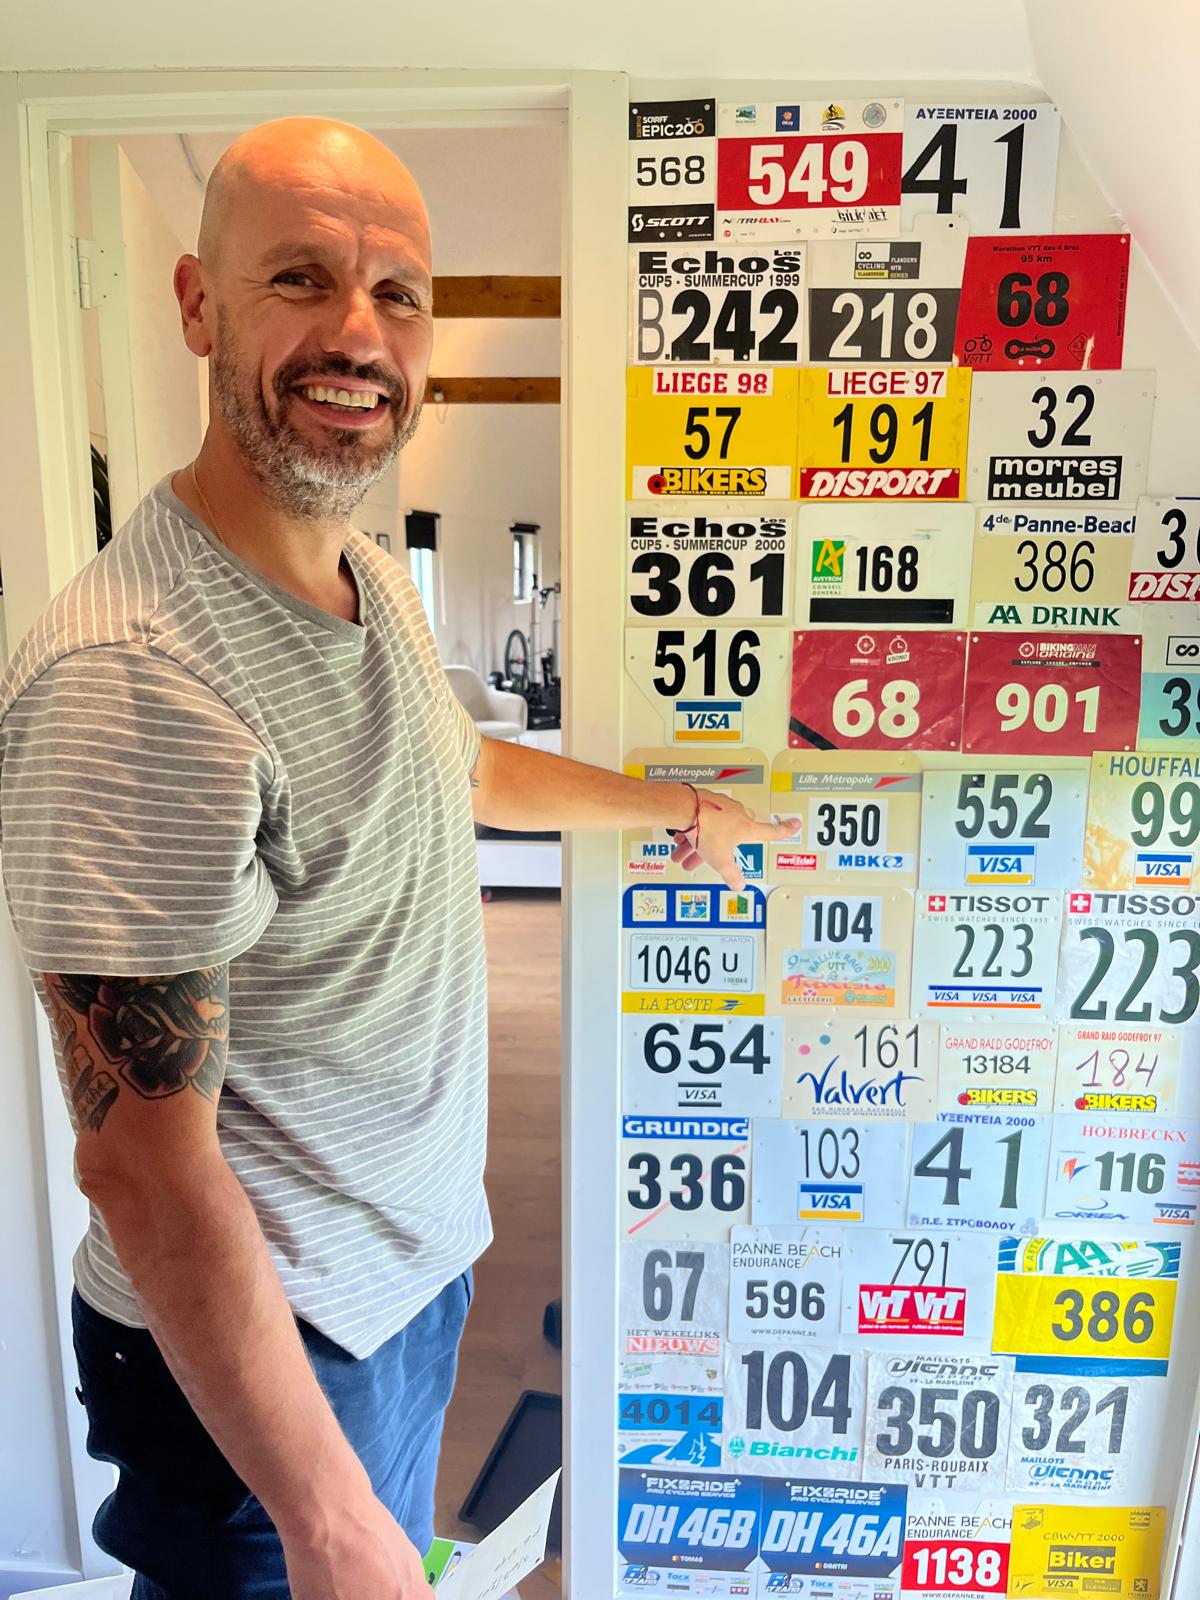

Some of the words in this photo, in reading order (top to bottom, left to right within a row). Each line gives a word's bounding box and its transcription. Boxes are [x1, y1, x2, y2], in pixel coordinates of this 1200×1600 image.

[1002, 109, 1037, 120] 2000
[636, 155, 705, 187] 568
[747, 140, 869, 206] 549
[901, 122, 1025, 229] 41
[645, 216, 710, 228] SCOTT
[638, 250, 801, 275] Echos
[773, 249, 802, 257] Les
[1021, 255, 1034, 264] 95
[1036, 254, 1053, 263] km
[639, 275, 672, 288] CUP5
[684, 274, 764, 288] SUMMERCUP
[769, 273, 800, 288] 1999
[997, 271, 1070, 328] 68
[828, 292, 938, 360] 218
[656, 372, 728, 394] LIEGE
[738, 373, 768, 395] 98
[827, 371, 906, 396] LIEGE
[914, 371, 945, 395] 97
[1027, 384, 1095, 449] 32
[684, 407, 741, 460] 57
[833, 401, 934, 464] 191
[994, 457, 1118, 476] morres
[662, 468, 767, 492] BIKERS
[808, 469, 953, 497] DISPORT
[992, 477, 1116, 498] meubel
[630, 517, 787, 538] Echos
[1156, 508, 1200, 569] 3
[631, 539, 662, 551] CUP5
[673, 539, 748, 551] SUMMERCUP
[755, 539, 786, 551] 2000
[856, 545, 919, 593] 168
[1014, 540, 1096, 593] 386
[630, 552, 785, 617] 361
[987, 605, 1023, 625] AA
[1032, 606, 1121, 627] DRINK
[653, 629, 760, 697] 516
[832, 679, 920, 739] 68
[995, 682, 1100, 734] 901
[1158, 677, 1200, 737] 3
[686, 713, 730, 729] VISA
[649, 767, 667, 777] Lille
[667, 767, 716, 781] Métropole
[799, 774, 818, 784] Lille
[821, 774, 873, 786] Métropole
[954, 773, 1053, 839] 552
[1130, 781, 1200, 848] 99
[817, 803, 881, 847] 350
[628, 862, 645, 870] Nord
[838, 854, 880, 868] MBK
[978, 857, 1022, 873] VISA
[1144, 863, 1182, 877] VISA
[949, 895, 1050, 913] TISSOT
[811, 901, 873, 943] 104
[1069, 918, 1099, 926] SWISS
[1105, 919, 1152, 927] WATCHES
[953, 923, 1034, 978] 223
[637, 944, 711, 984] 1046
[722, 953, 738, 973] U
[1069, 926, 1200, 1024] 223
[640, 998, 660, 1011] LA
[663, 998, 713, 1011] POSTE
[934, 991, 959, 1001] VISA
[971, 992, 997, 1002] VISA
[1010, 992, 1036, 1003] VISA
[854, 1023, 919, 1069] 161
[945, 1037, 978, 1050] GRAND
[980, 1037, 1002, 1050] RAID
[1004, 1037, 1054, 1051] GODEFROY
[1077, 1031, 1100, 1040] GRAND
[1101, 1032, 1117, 1041] RAID
[1118, 1032, 1153, 1042] GODEFROY
[1154, 1032, 1162, 1042] 97
[643, 1022, 771, 1075] 654
[962, 1054, 1031, 1075] 13184
[1076, 1048, 1159, 1088] 184
[796, 1055, 926, 1107] Valvert
[684, 1088, 718, 1101] VISA
[967, 1088, 1038, 1105] BIKERS
[1084, 1093, 1158, 1110] BIKERS
[1005, 1116, 1036, 1128] 2000
[1082, 1125, 1187, 1143] HOEBRECKX
[800, 1127, 860, 1179] 103
[914, 1126, 1023, 1209] 41
[1095, 1151, 1166, 1195] 116
[627, 1152, 746, 1212] 336
[811, 1194, 852, 1209] VISA
[1055, 1210, 1129, 1221] ORBEA
[1159, 1208, 1190, 1219] VISA
[733, 1243, 782, 1255] PANNE
[788, 1243, 841, 1258] BEACH
[1054, 1240, 1114, 1275] AA
[733, 1258, 800, 1269] ENDURANCE
[890, 1238, 949, 1287] 791
[643, 1248, 705, 1322] 67
[745, 1279, 825, 1322] 596
[860, 1290, 911, 1323] VTT
[913, 1291, 965, 1324] VTT
[1051, 1288, 1155, 1344] 386
[627, 1329, 650, 1337] HET
[653, 1329, 720, 1339] WEKELIJKS
[627, 1337, 720, 1354] NIEUWS
[916, 1355, 971, 1364] MAILLOTS
[741, 1350, 852, 1435] 104
[621, 1398, 722, 1428] 4014
[876, 1386, 1000, 1460] 350
[1022, 1384, 1129, 1454] 321
[750, 1441, 859, 1463] Bianchi
[1020, 1456, 1065, 1465] MAILLOTS
[884, 1457, 989, 1473] PARIS-ROUBAIX
[915, 1474, 957, 1489] VTT
[1063, 1482, 1112, 1491] MADELEINE
[667, 1489, 699, 1497] CYCLING
[810, 1497, 843, 1505] CYCLING
[623, 1503, 680, 1544] DH
[677, 1507, 757, 1549] 46B
[761, 1510, 824, 1553] DH
[820, 1513, 902, 1557] 46A
[907, 1528, 973, 1539] ENDURANCE
[908, 1515, 956, 1527] PANNE
[961, 1516, 1012, 1530] BEACH
[1097, 1533, 1125, 1542] 2000
[680, 1555, 704, 1563] TOMAS
[912, 1547, 1001, 1587] 1138
[1049, 1551, 1115, 1569] Biker
[1047, 1580, 1074, 1588] VISA
